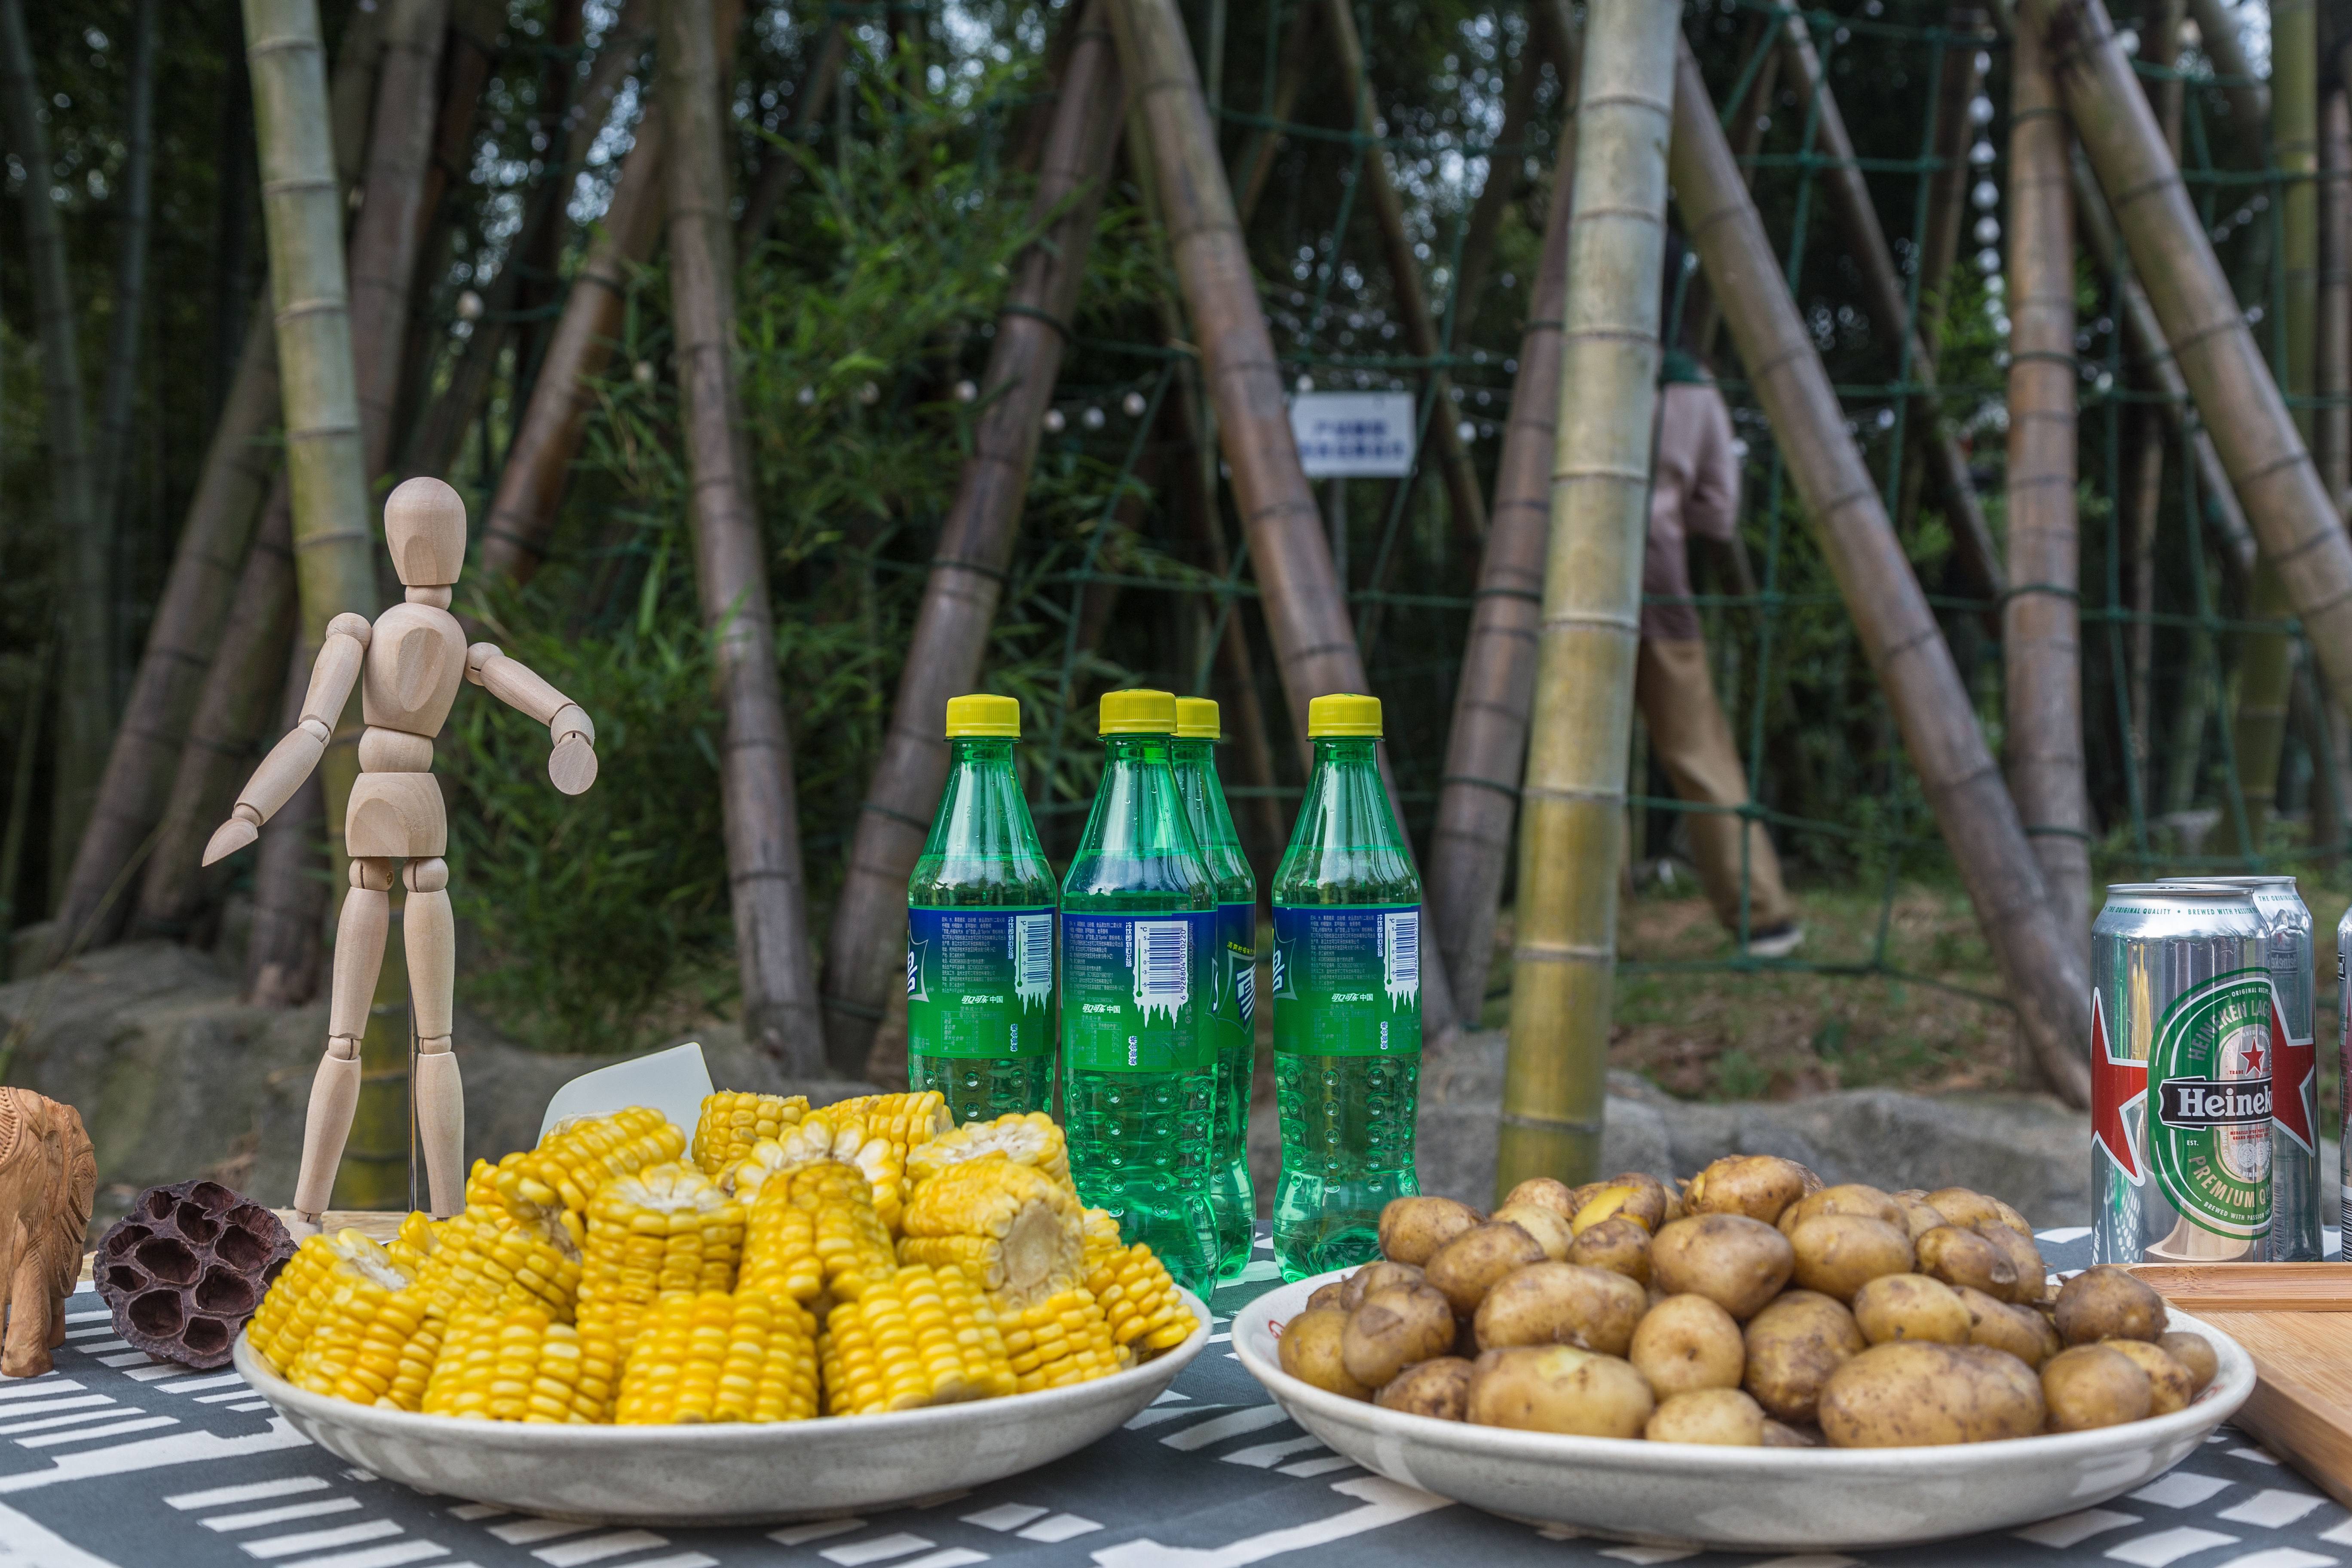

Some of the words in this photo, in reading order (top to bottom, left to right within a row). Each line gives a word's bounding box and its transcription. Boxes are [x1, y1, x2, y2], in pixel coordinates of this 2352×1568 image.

[2232, 987, 2256, 997] ORIGINAL
[2187, 1001, 2247, 1061] HEINEKEN
[2177, 1085, 2272, 1117] Heinek
[2188, 1155, 2255, 1208] PREMIUM
[2204, 1201, 2228, 1216] BREWED
[2231, 1212, 2245, 1220] WITH
[2247, 1212, 2264, 1220] PASSION
